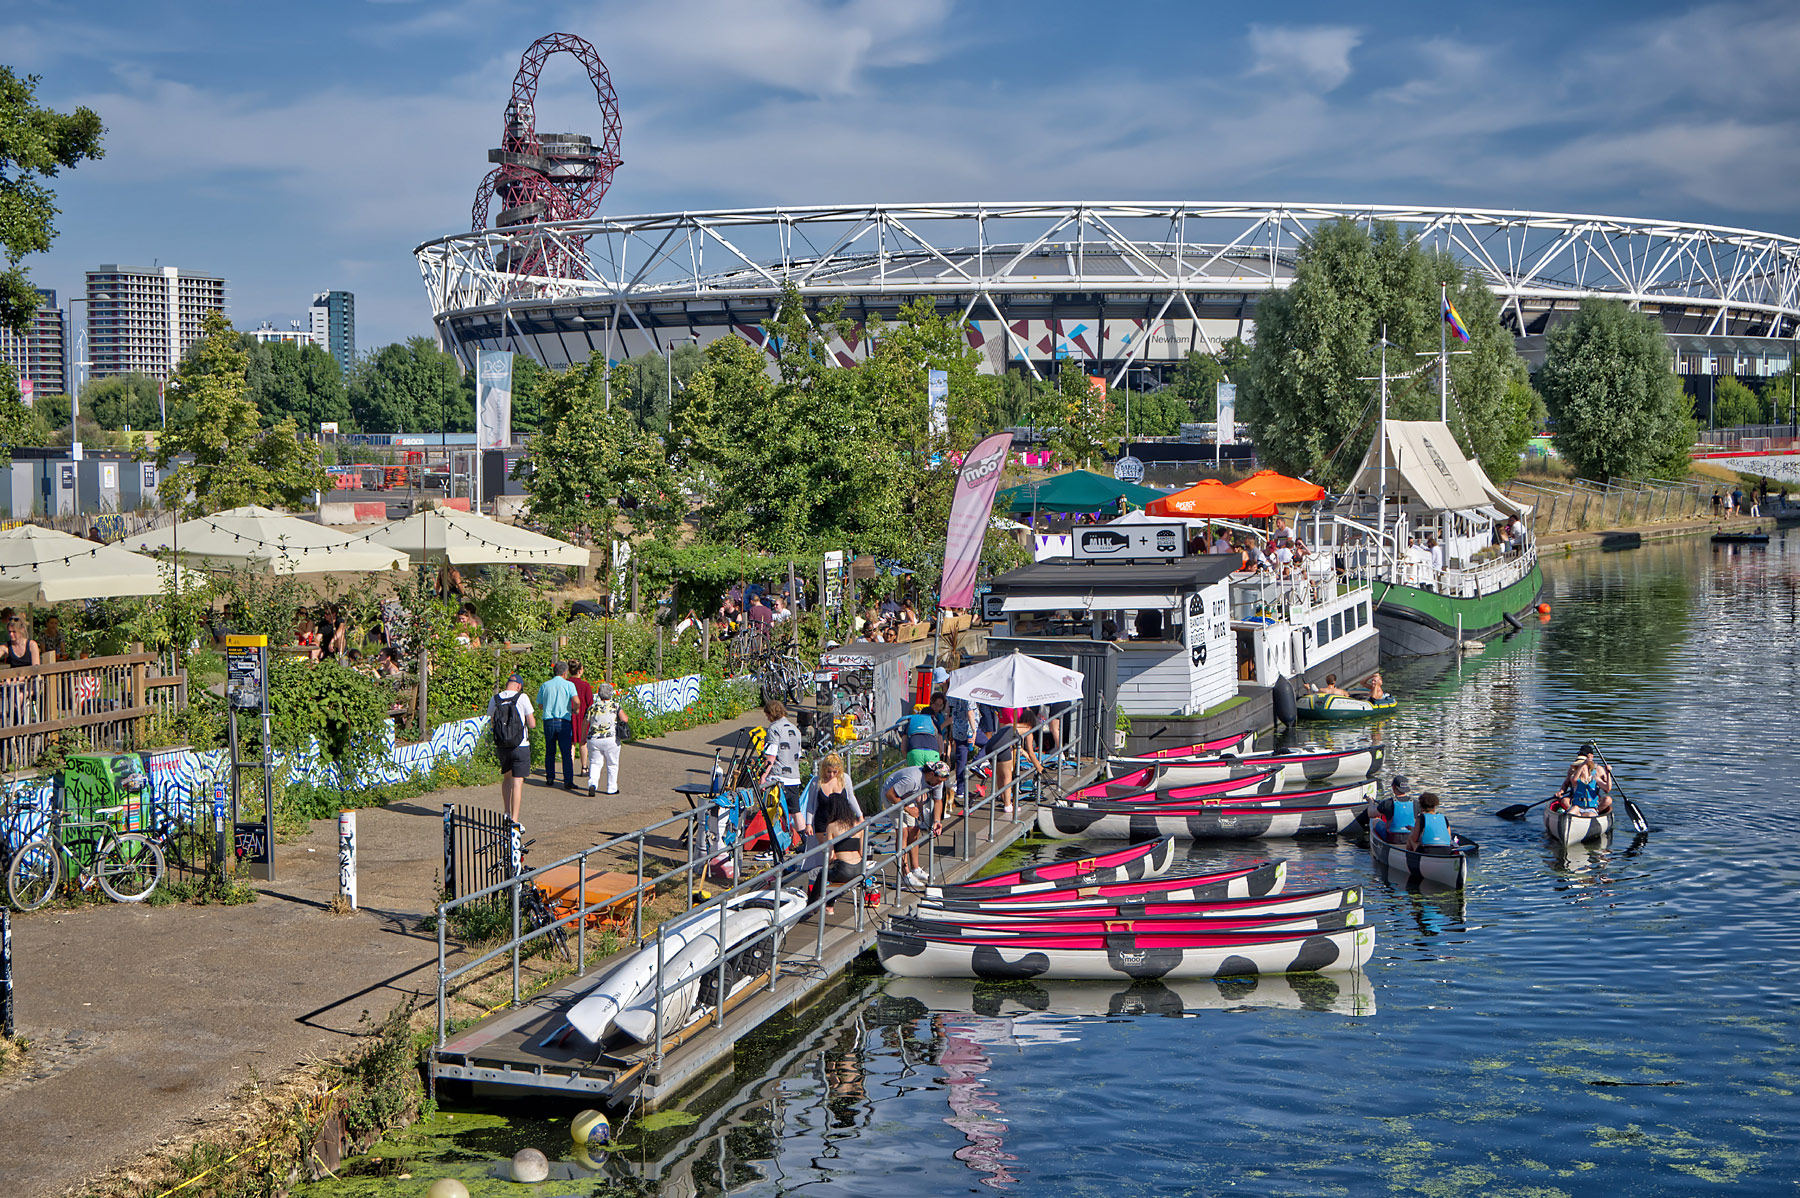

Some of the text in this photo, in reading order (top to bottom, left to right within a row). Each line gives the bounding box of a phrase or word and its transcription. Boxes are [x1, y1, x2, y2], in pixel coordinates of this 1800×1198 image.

[1151, 335, 1190, 344] Newham
[964, 461, 998, 483] moo
[1175, 500, 1197, 508] APEROL
[1089, 537, 1113, 547] MILK
[1212, 598, 1226, 617] DIRTY
[1189, 615, 1205, 628] BANDITO
[1213, 621, 1226, 639] DOGS
[1190, 631, 1206, 645] BURGER
[1124, 956, 1142, 964] moo
